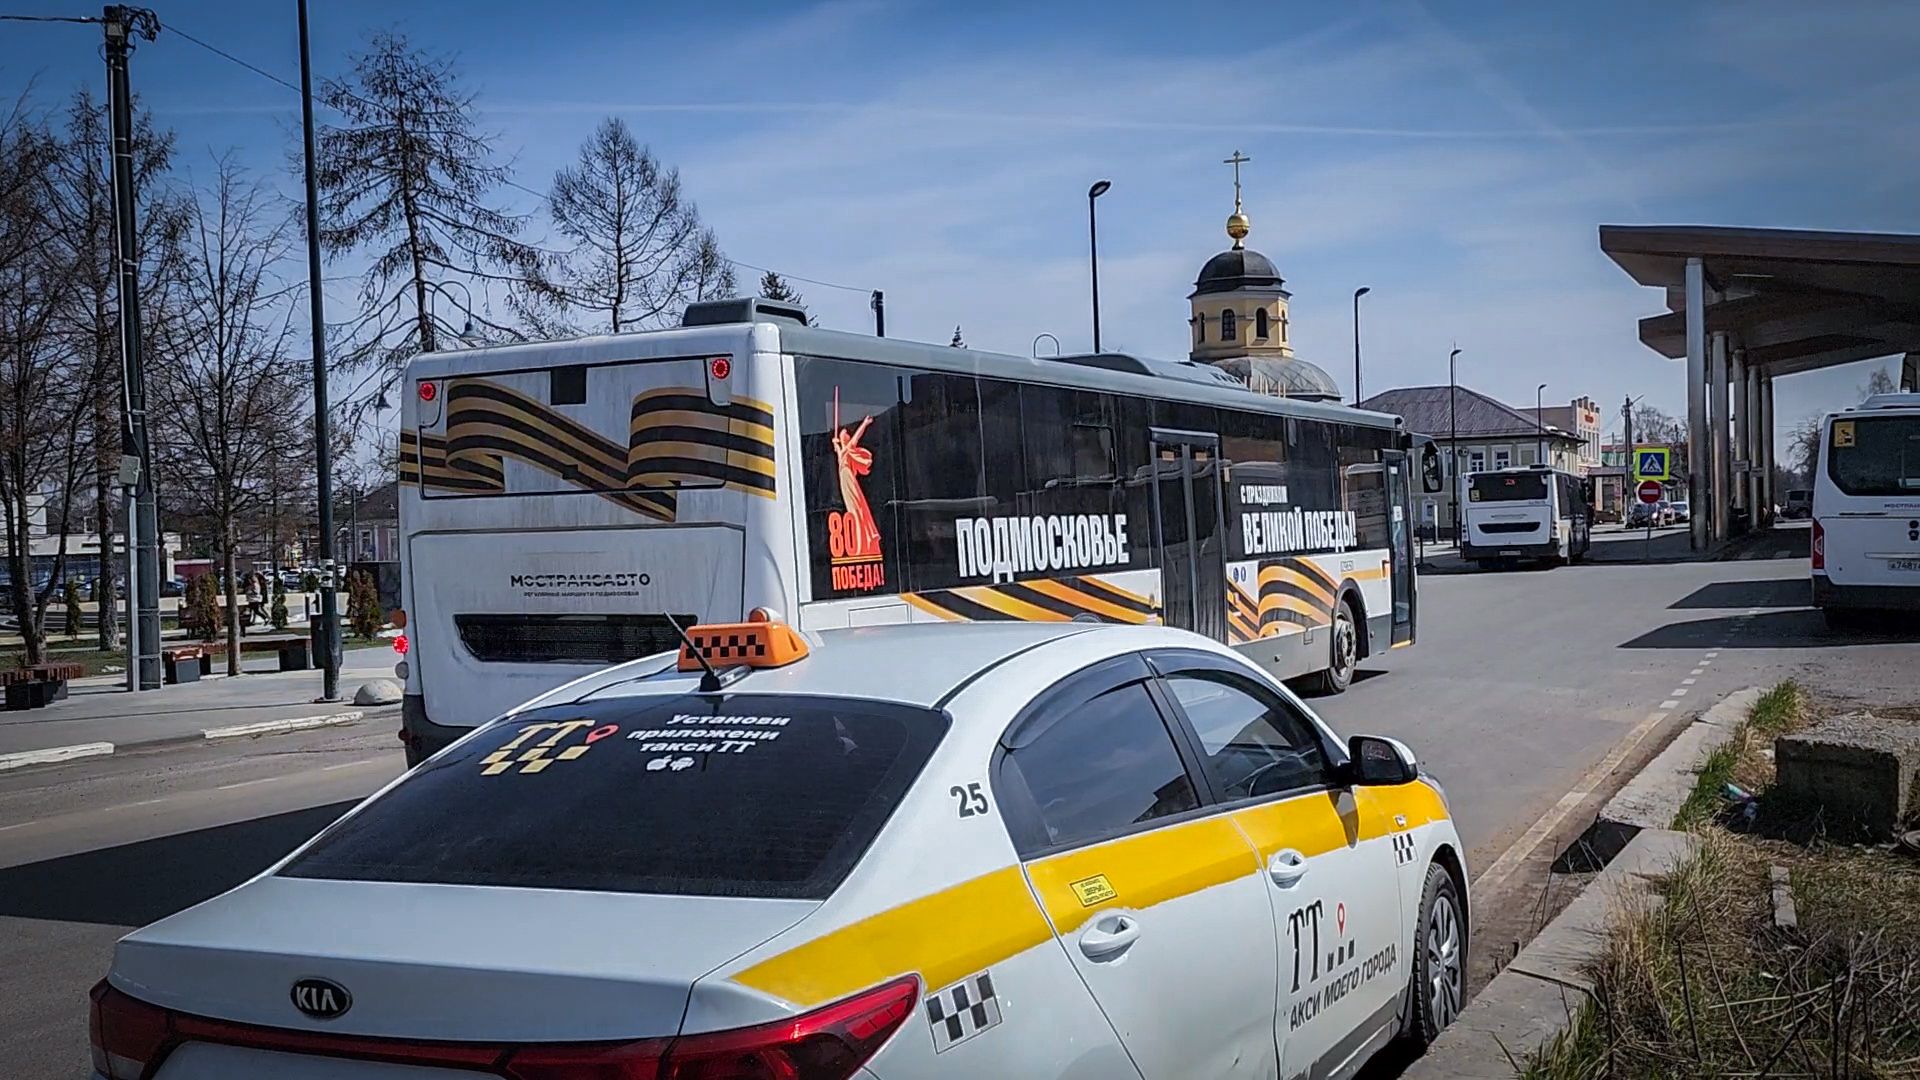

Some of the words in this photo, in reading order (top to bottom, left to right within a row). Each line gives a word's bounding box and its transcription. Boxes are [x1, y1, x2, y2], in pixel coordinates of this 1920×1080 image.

[828, 511, 860, 557] 80
[1242, 506, 1305, 555] ВЕЛИКОЙ
[1304, 510, 1358, 553] ПОБЕДЫ!
[955, 514, 1130, 584] ПОДМОСКОВЬЕ
[510, 573, 651, 587] МОСТРАНСАВТО
[831, 563, 885, 592] ПОБЕДА!
[666, 714, 791, 726] Установи
[626, 729, 780, 741] приложени
[640, 742, 717, 752] такси
[950, 782, 988, 818] 25
[1323, 967, 1360, 1010] МОЕГО
[1360, 943, 1397, 985] ГОРОДА
[296, 986, 339, 1011] KIA
